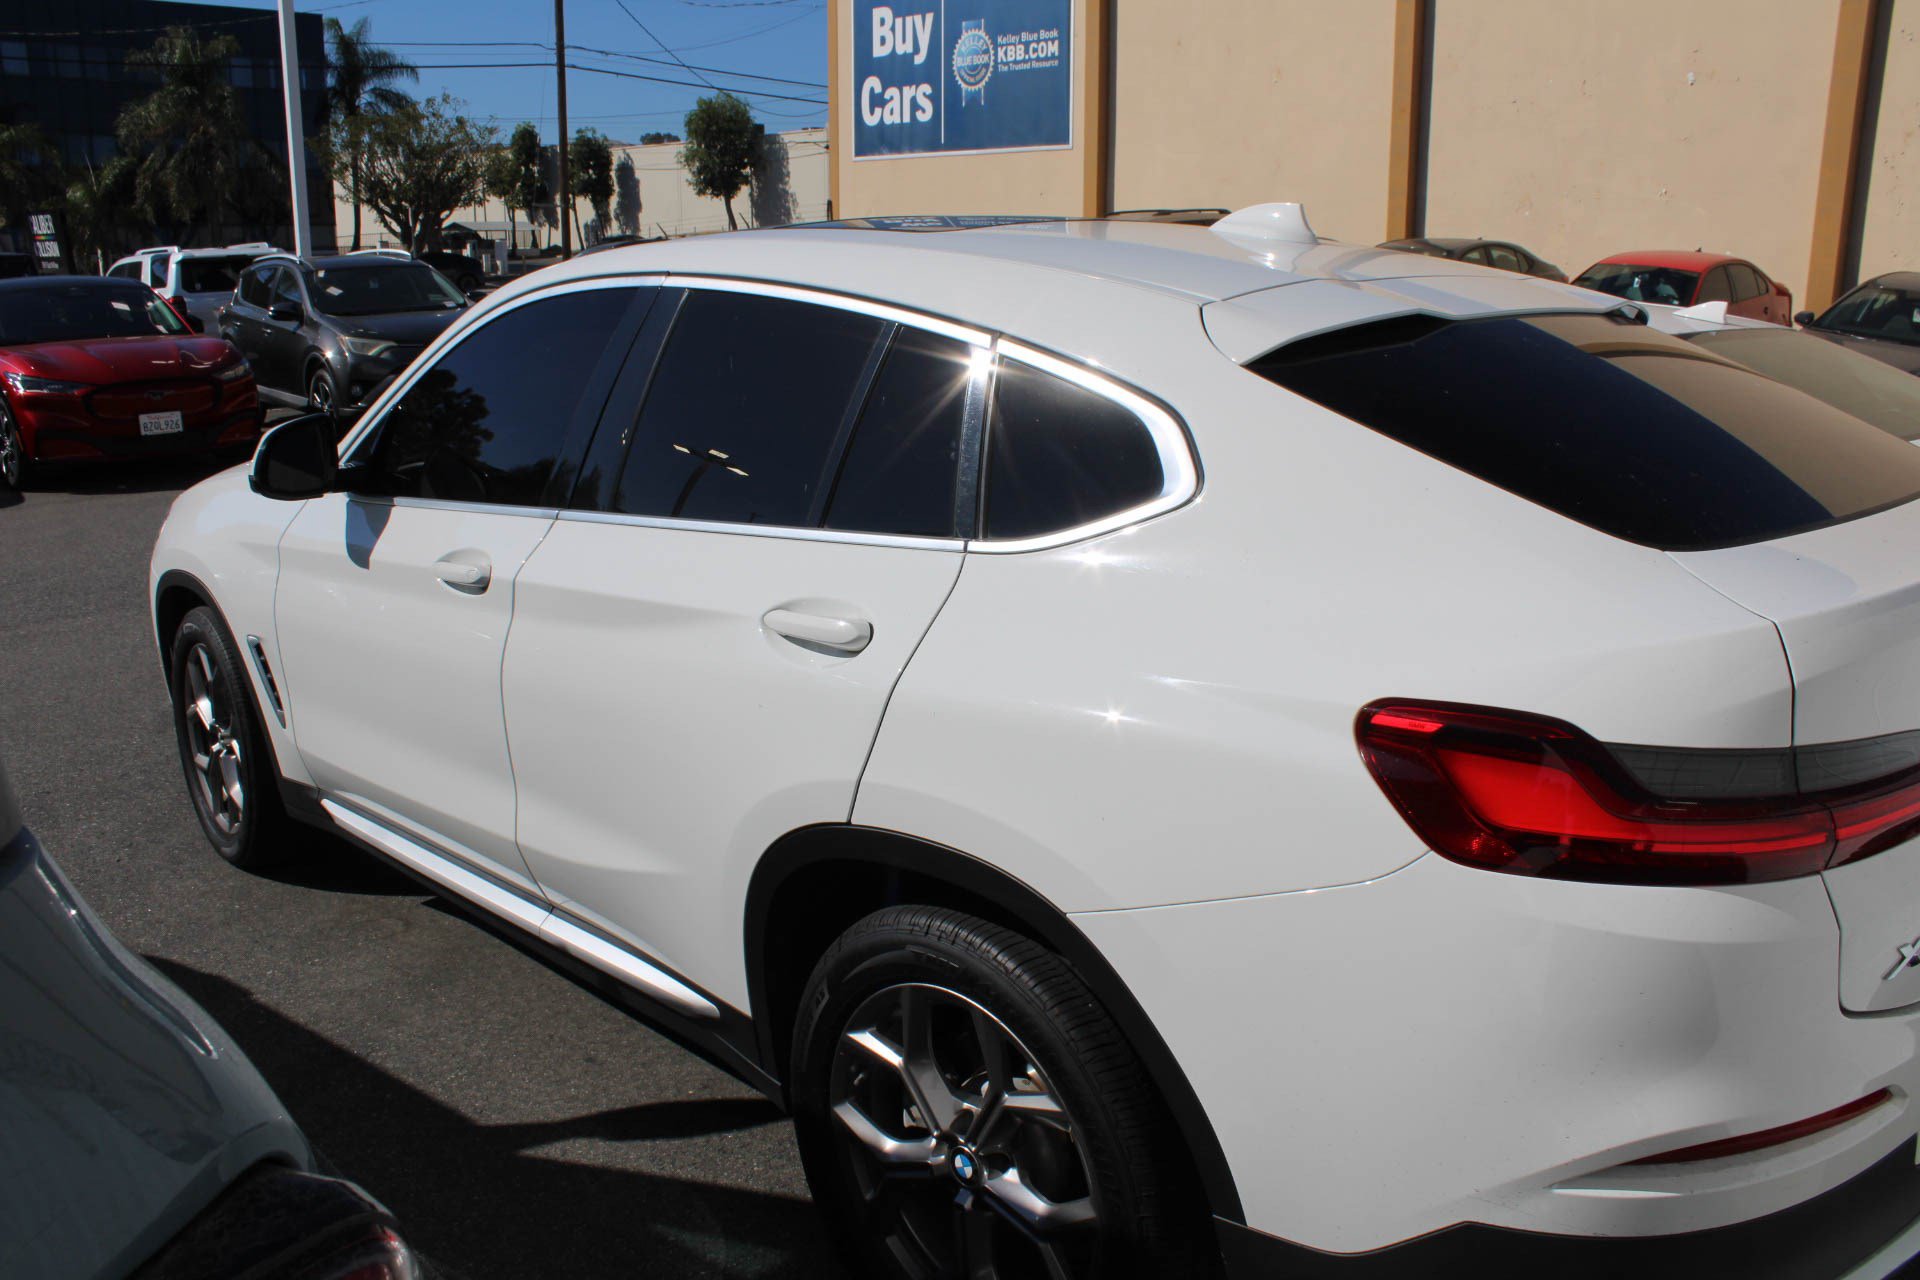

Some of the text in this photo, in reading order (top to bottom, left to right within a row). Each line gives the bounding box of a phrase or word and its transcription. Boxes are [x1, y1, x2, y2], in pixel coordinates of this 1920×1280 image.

[872, 6, 934, 65] Buy
[997, 28, 1059, 45] Kelley Blue Book
[973, 53, 990, 65] BOOK
[997, 39, 1059, 63] KBB.COM
[997, 59, 1059, 73] The Trusted Resource
[861, 75, 933, 126] Cars
